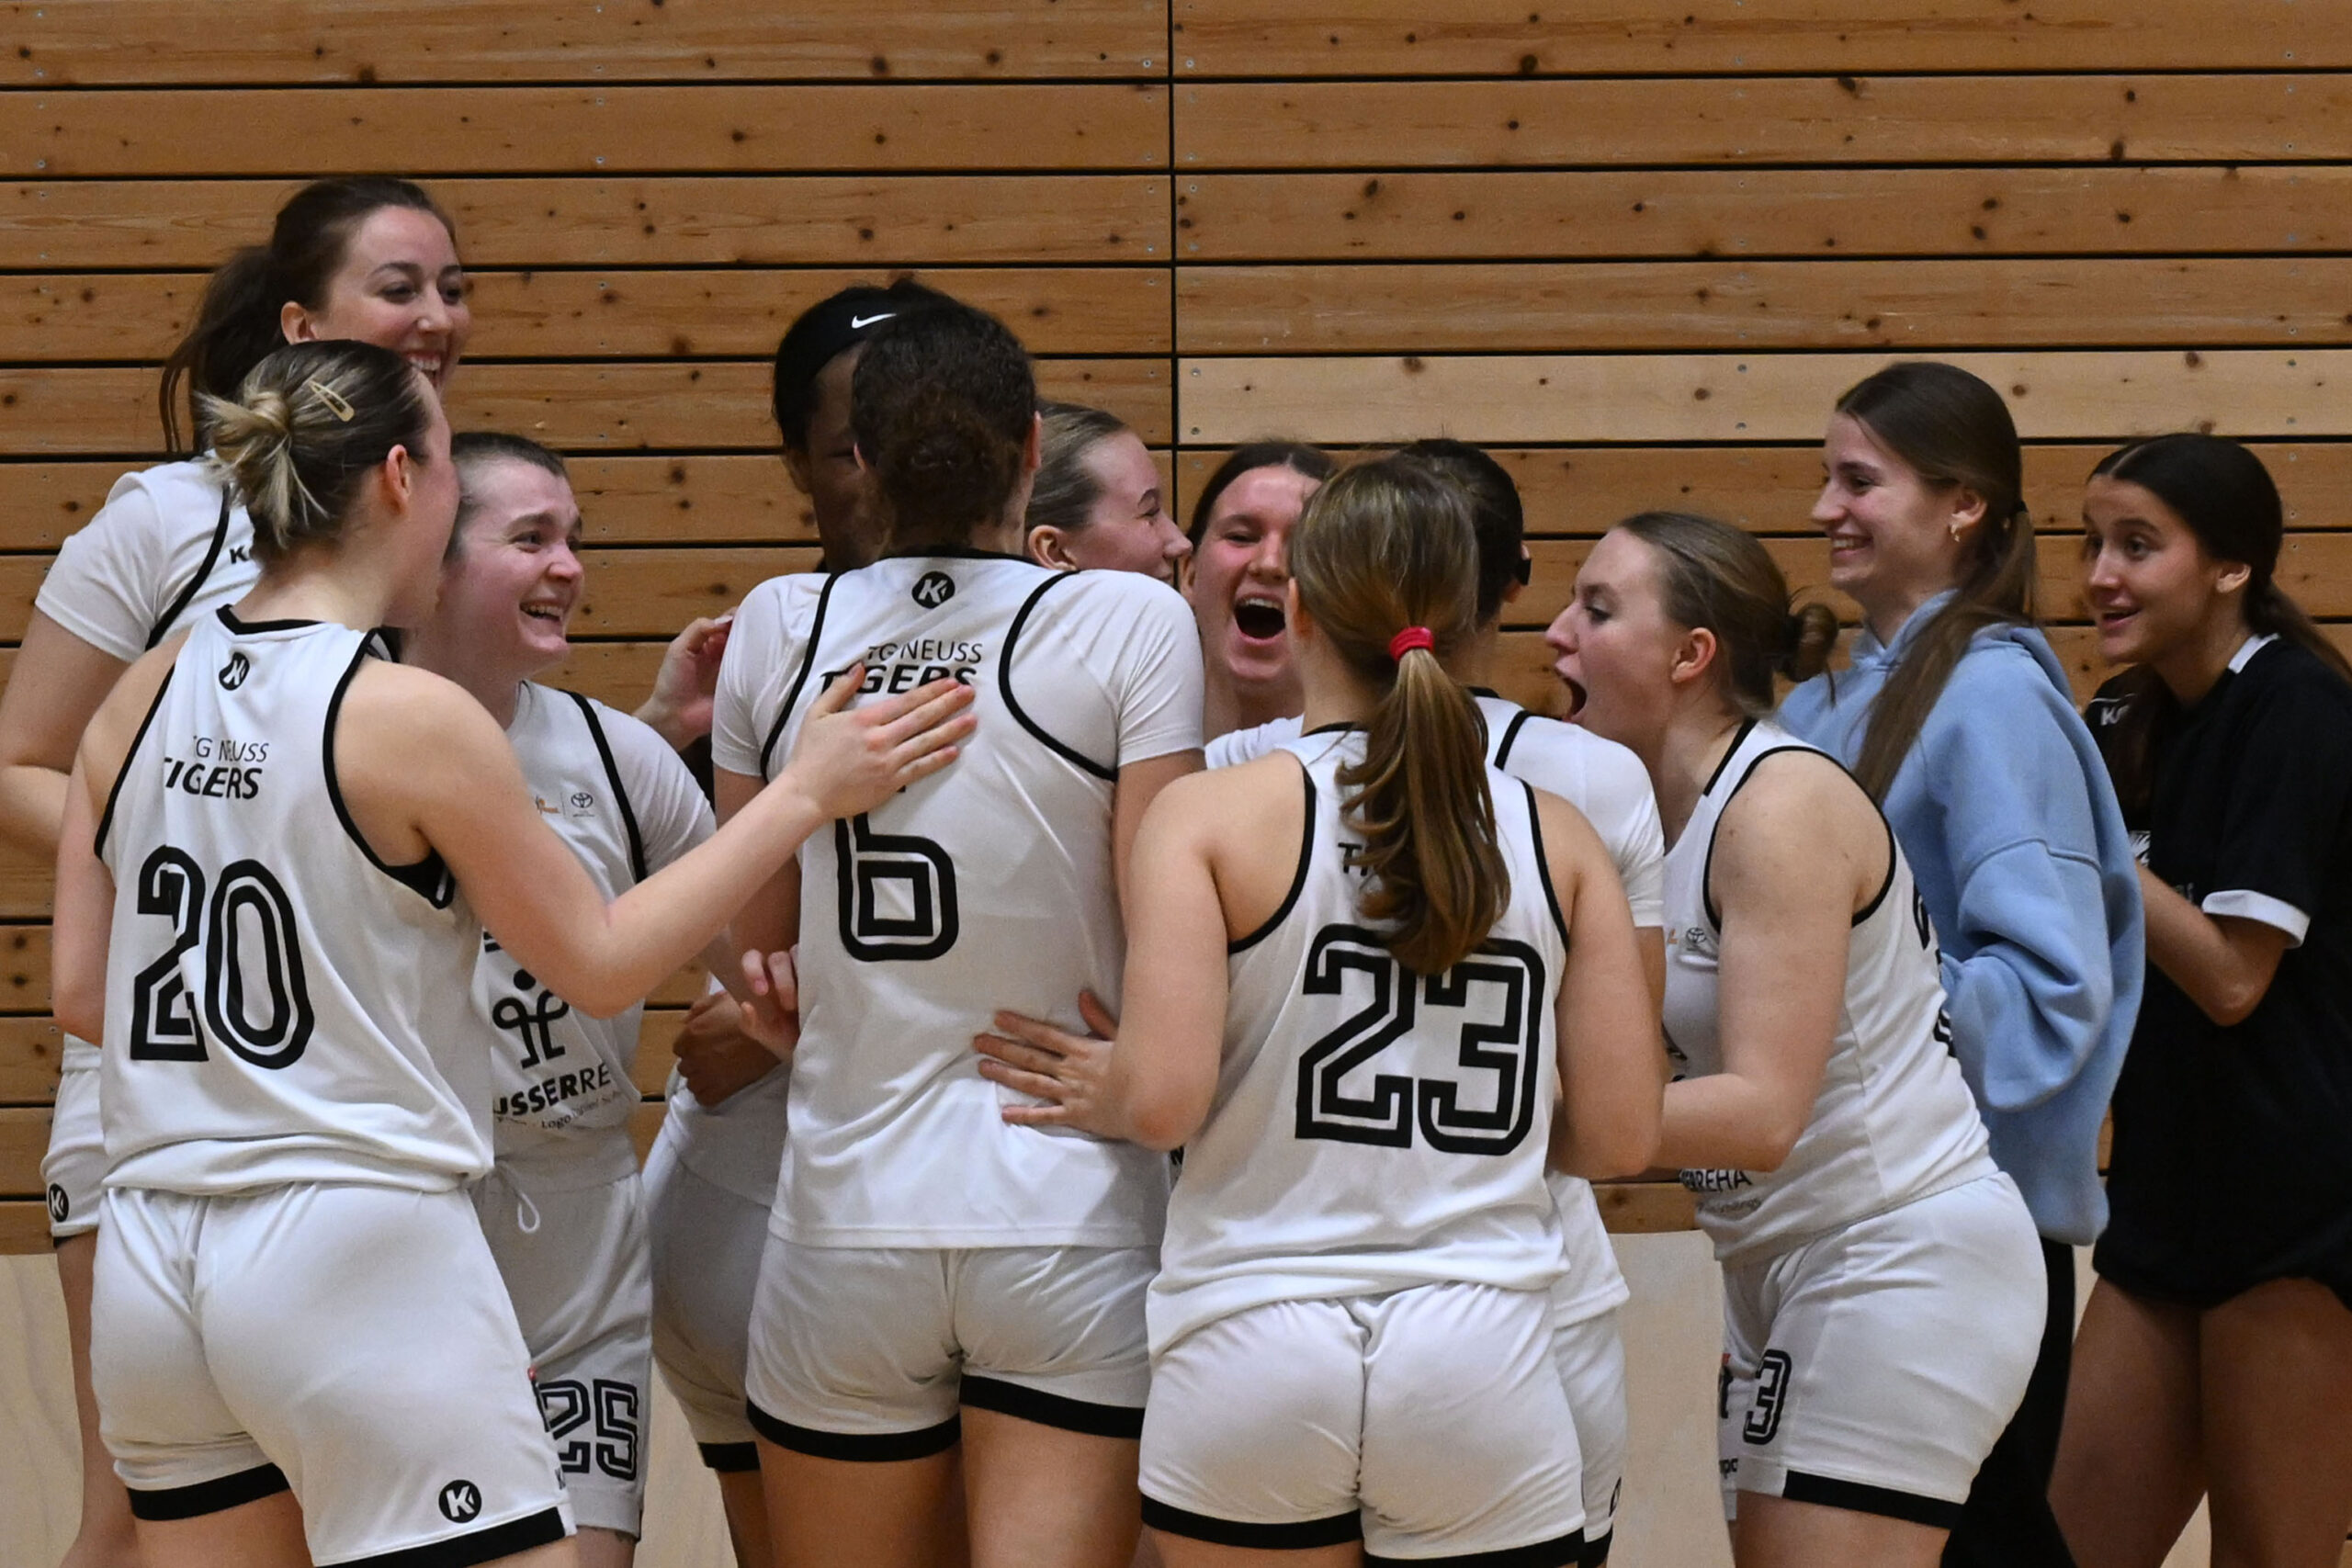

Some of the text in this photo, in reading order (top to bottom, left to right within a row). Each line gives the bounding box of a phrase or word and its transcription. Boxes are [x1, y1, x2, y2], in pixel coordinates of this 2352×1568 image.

[820, 663, 977, 695] TGERS
[899, 638, 983, 663] NEUSS
[834, 787, 959, 962] 6
[130, 844, 315, 1070] 20
[1295, 922, 1545, 1156] 23
[1742, 1348, 1792, 1446] 3
